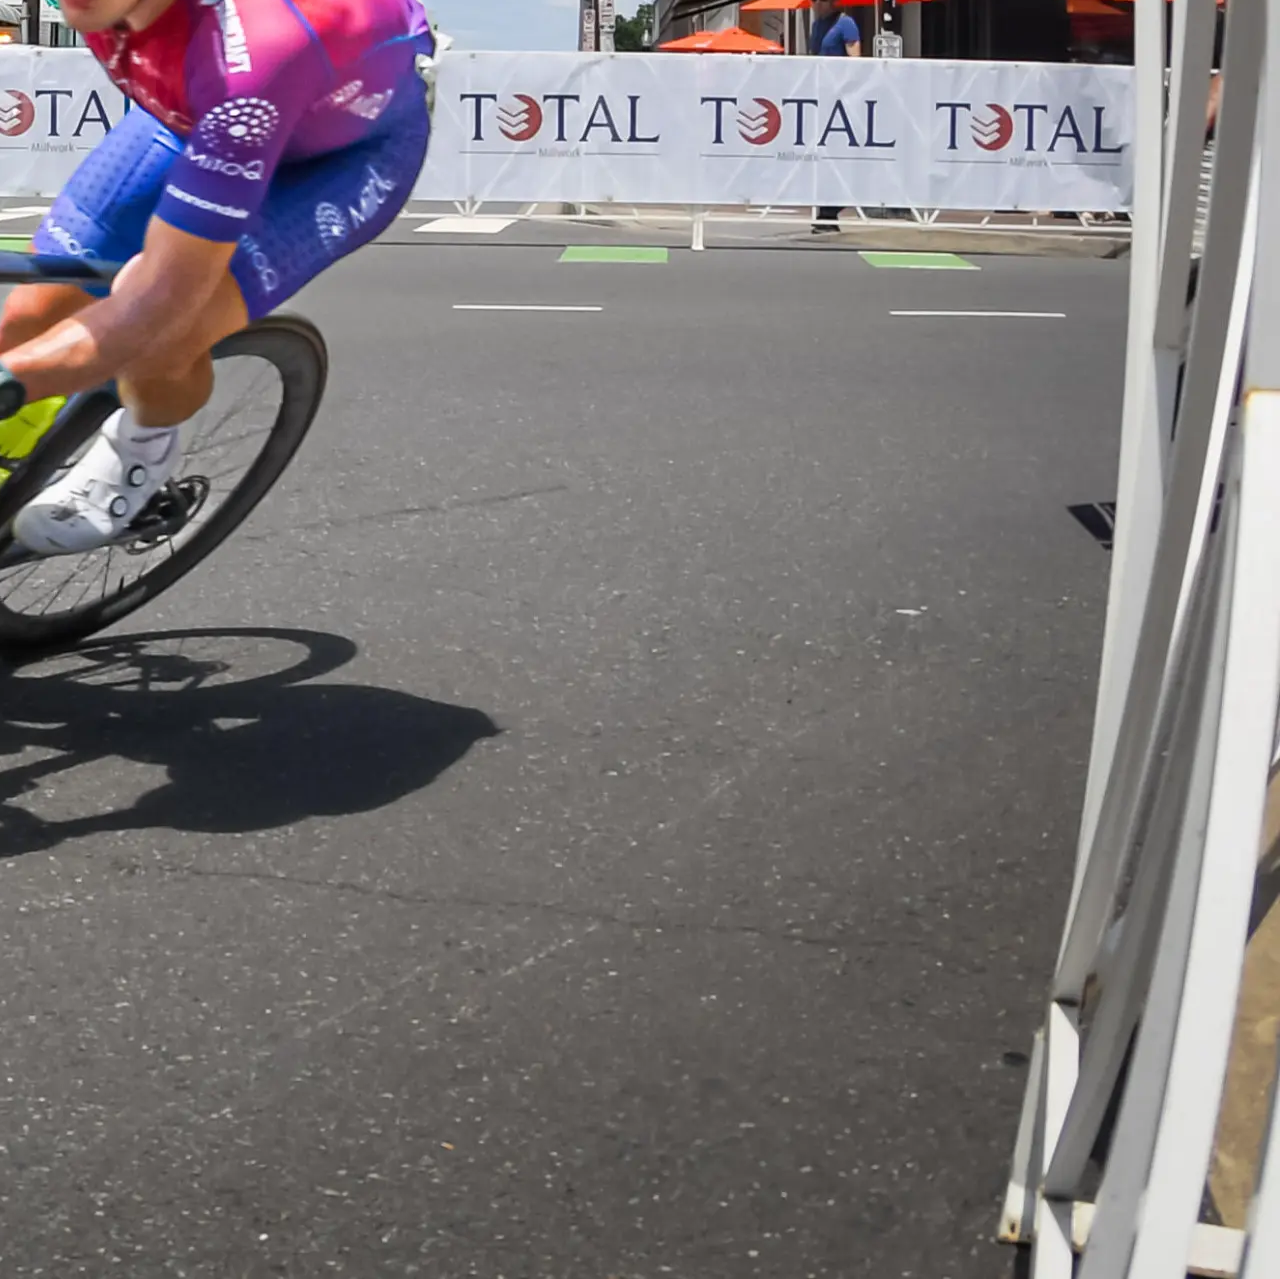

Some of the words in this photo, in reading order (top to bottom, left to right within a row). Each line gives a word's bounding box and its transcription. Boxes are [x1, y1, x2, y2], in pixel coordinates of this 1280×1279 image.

[460, 93, 660, 143] TOTAL
[700, 96, 896, 148] TOTAL
[935, 102, 1130, 154] TOTAL
[31, 142, 74, 154] Millwork
